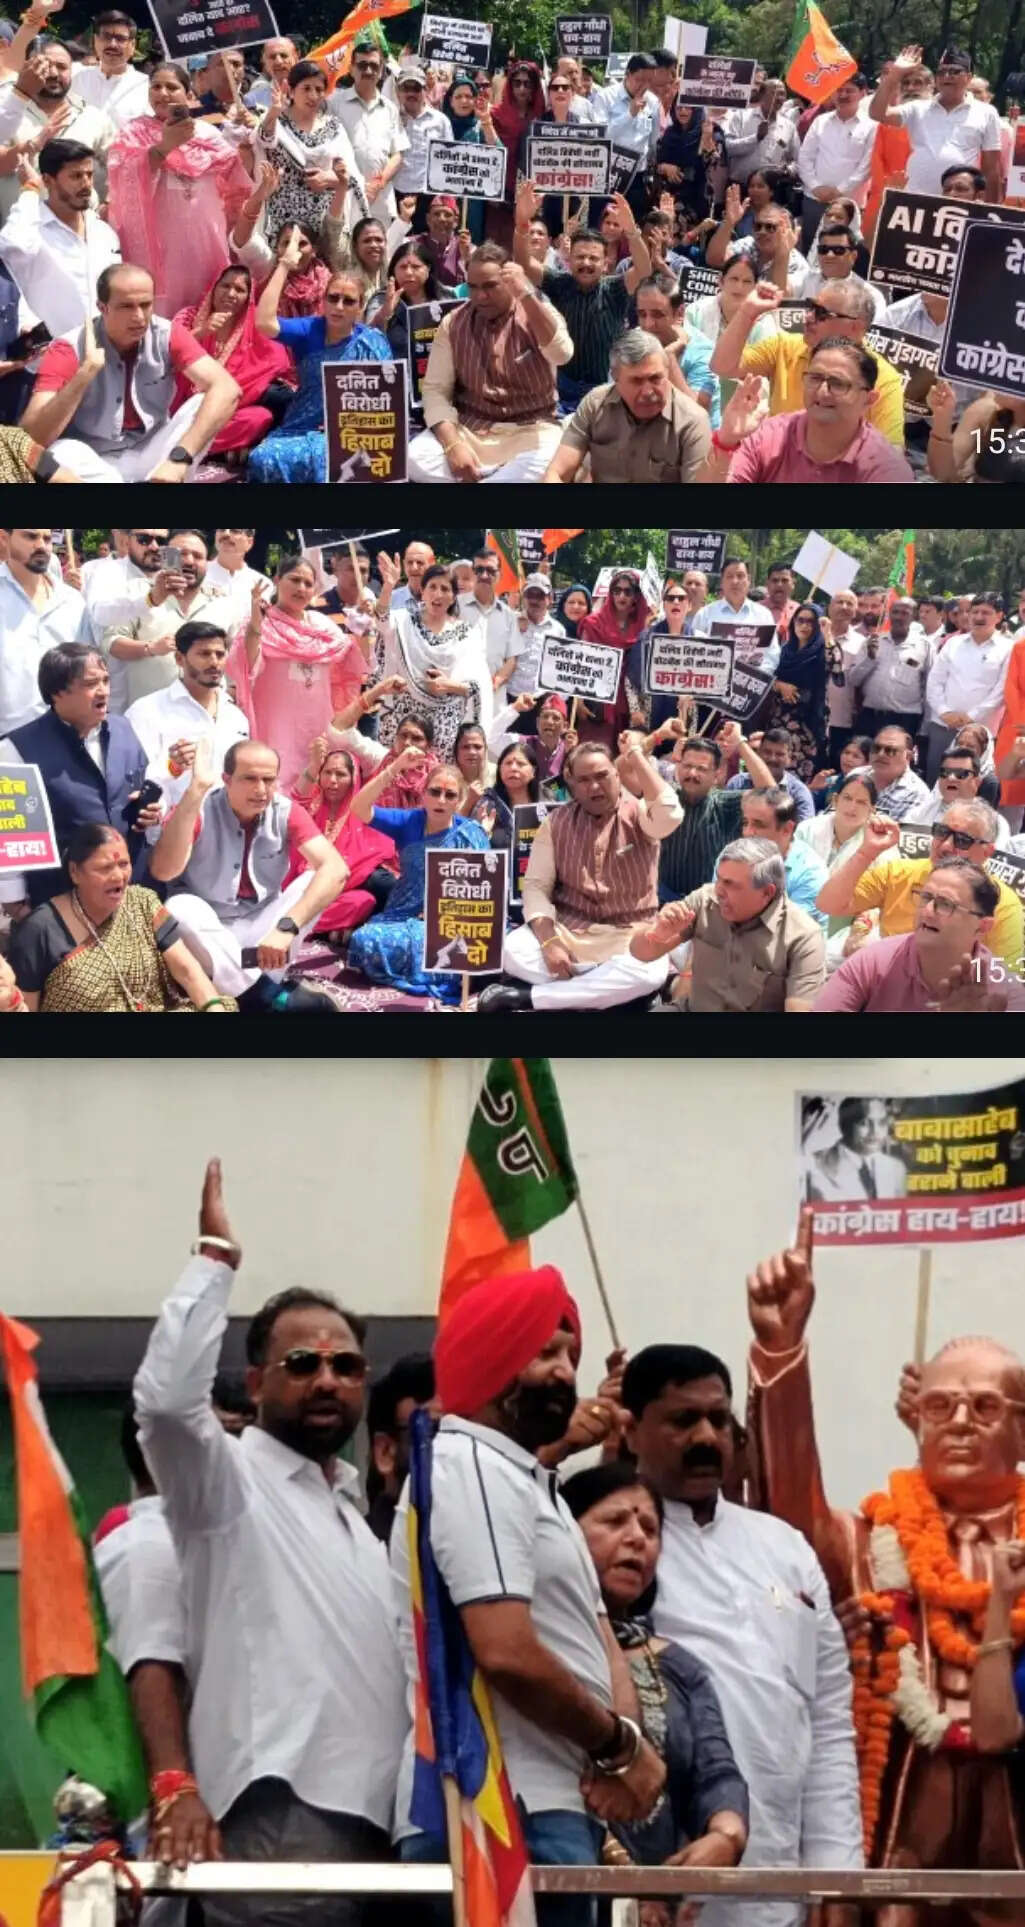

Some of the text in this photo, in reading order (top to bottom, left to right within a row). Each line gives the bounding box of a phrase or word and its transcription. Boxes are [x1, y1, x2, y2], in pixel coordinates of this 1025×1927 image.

[536, 168, 594, 189] कांग्रेस!
[888, 206, 925, 235] AI
[335, 370, 380, 390] दलित
[341, 392, 392, 411] विरोधी
[340, 428, 395, 452] हिसाब
[370, 451, 393, 477] दो
[655, 667, 715, 688] कांग्रेस!
[437, 858, 482, 878] दलित
[440, 879, 492, 900] विरोधी
[439, 915, 493, 939] हिसाब
[466, 939, 489, 966] दो
[893, 1105, 1018, 1141] बाबासाहेब
[915, 1142, 999, 1169] को चुनाव
[960, 1163, 1007, 1187] वाली
[811, 1203, 902, 1237] कांग्रेस
